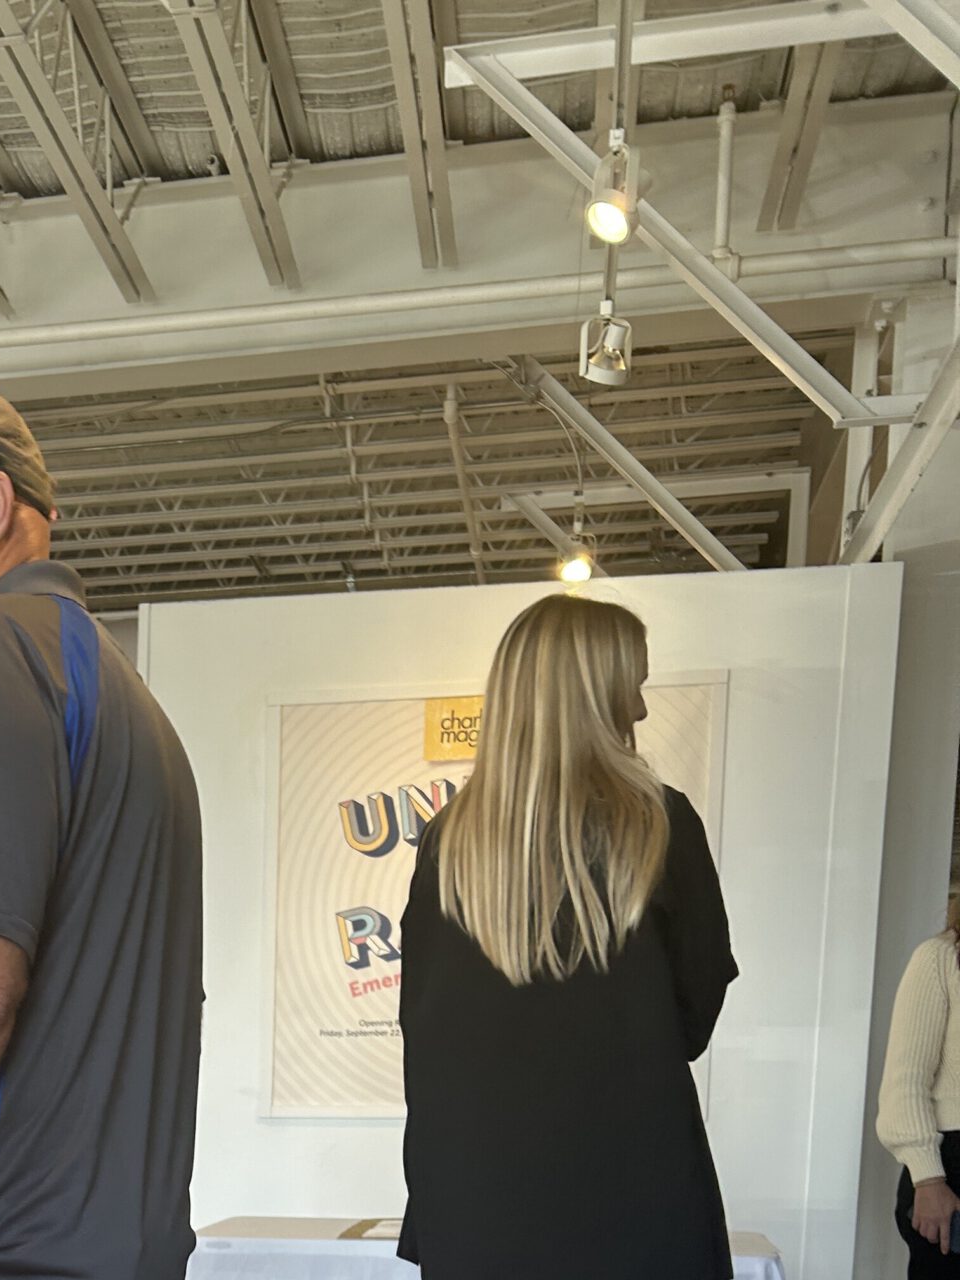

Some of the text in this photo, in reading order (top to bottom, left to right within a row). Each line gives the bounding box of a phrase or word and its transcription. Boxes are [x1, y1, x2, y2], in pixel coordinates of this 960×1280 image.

[339, 777, 472, 858] UN
[336, 906, 401, 969] R
[345, 1029, 388, 1037] September
[359, 1020, 393, 1028] Opening
